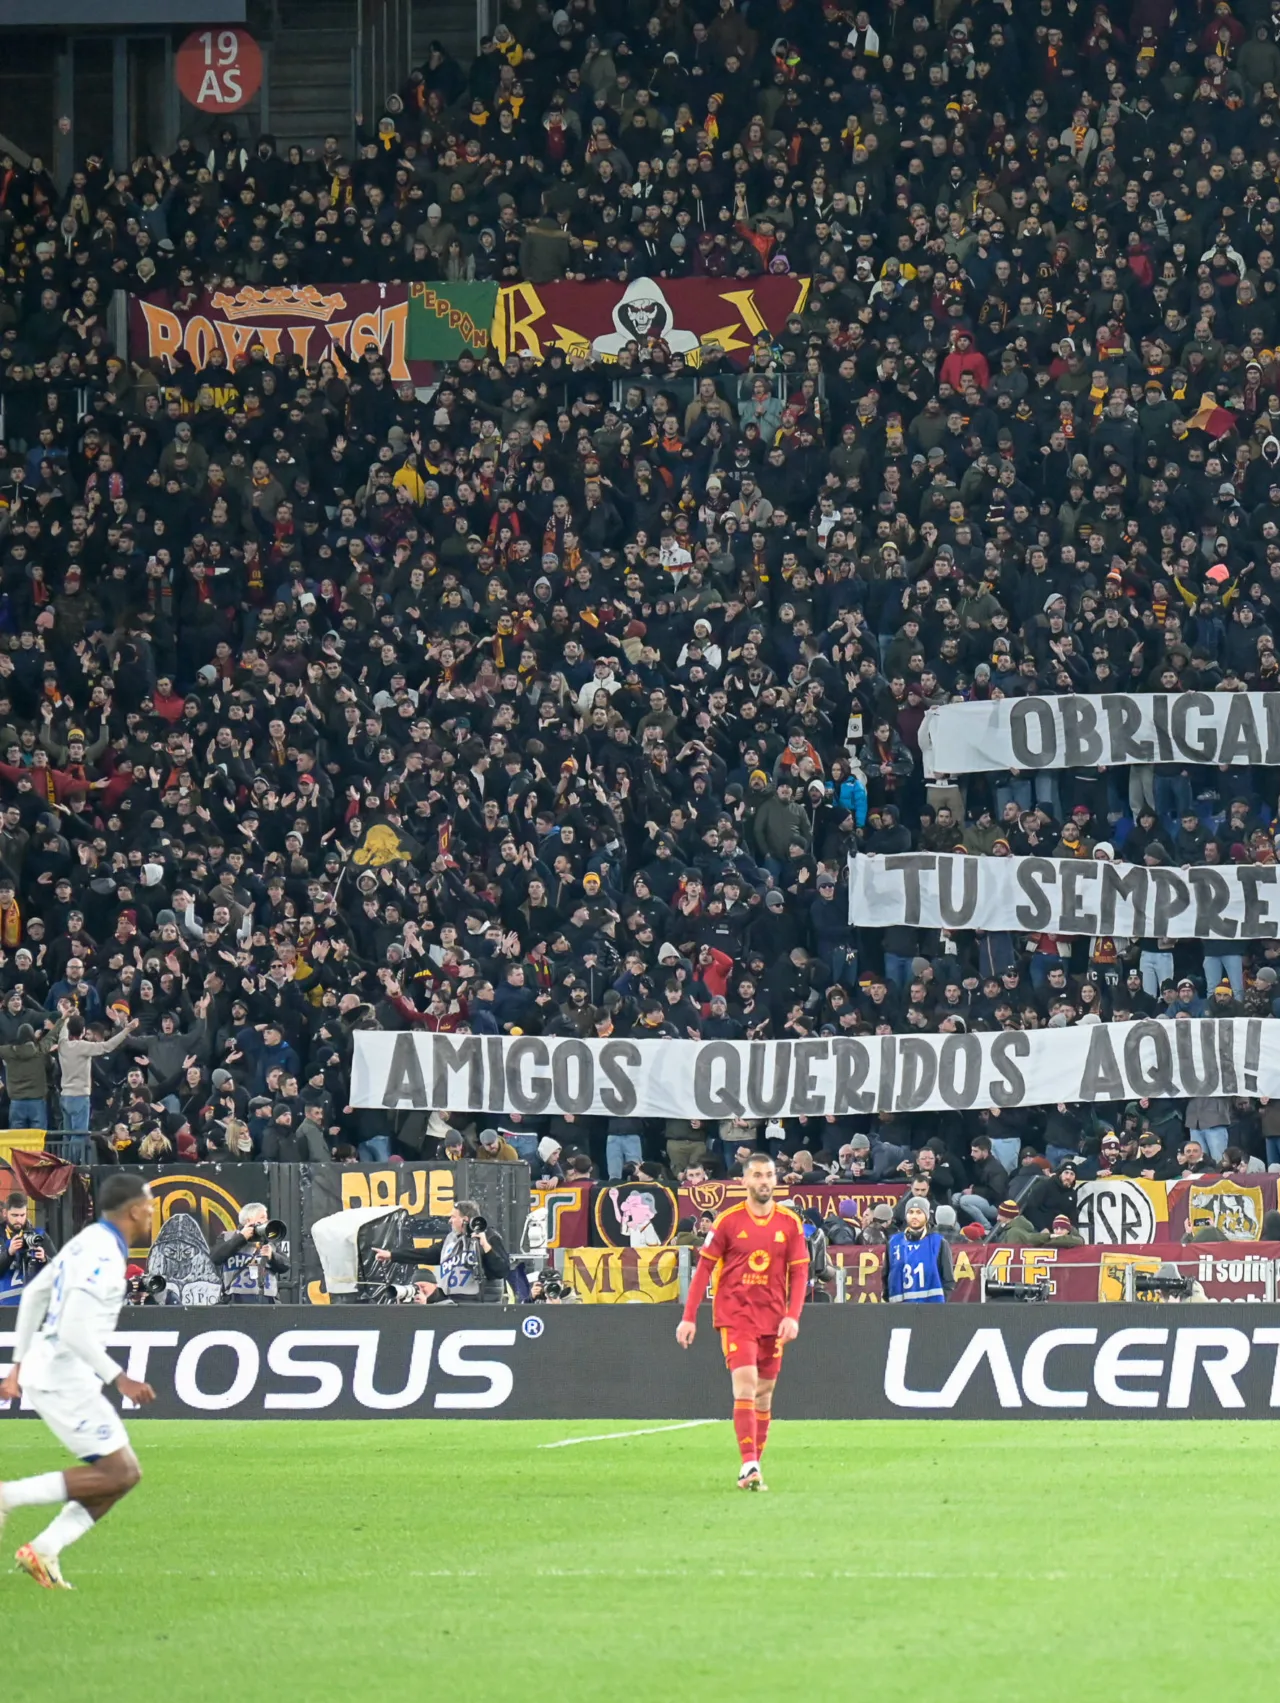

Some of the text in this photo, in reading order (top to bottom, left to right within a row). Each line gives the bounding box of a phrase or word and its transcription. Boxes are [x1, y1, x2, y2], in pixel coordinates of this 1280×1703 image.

[199, 31, 238, 65] 19
[196, 68, 243, 104] AS
[884, 856, 979, 926] TU
[1015, 857, 1279, 939] SEMPRE
[381, 1018, 1263, 1119] AMIGOS QUERIDOS AQUI!
[341, 1170, 455, 1217] DAJE
[447, 1270, 472, 1288] 67
[903, 1262, 926, 1289] 31
[1216, 1255, 1279, 1283] solit
